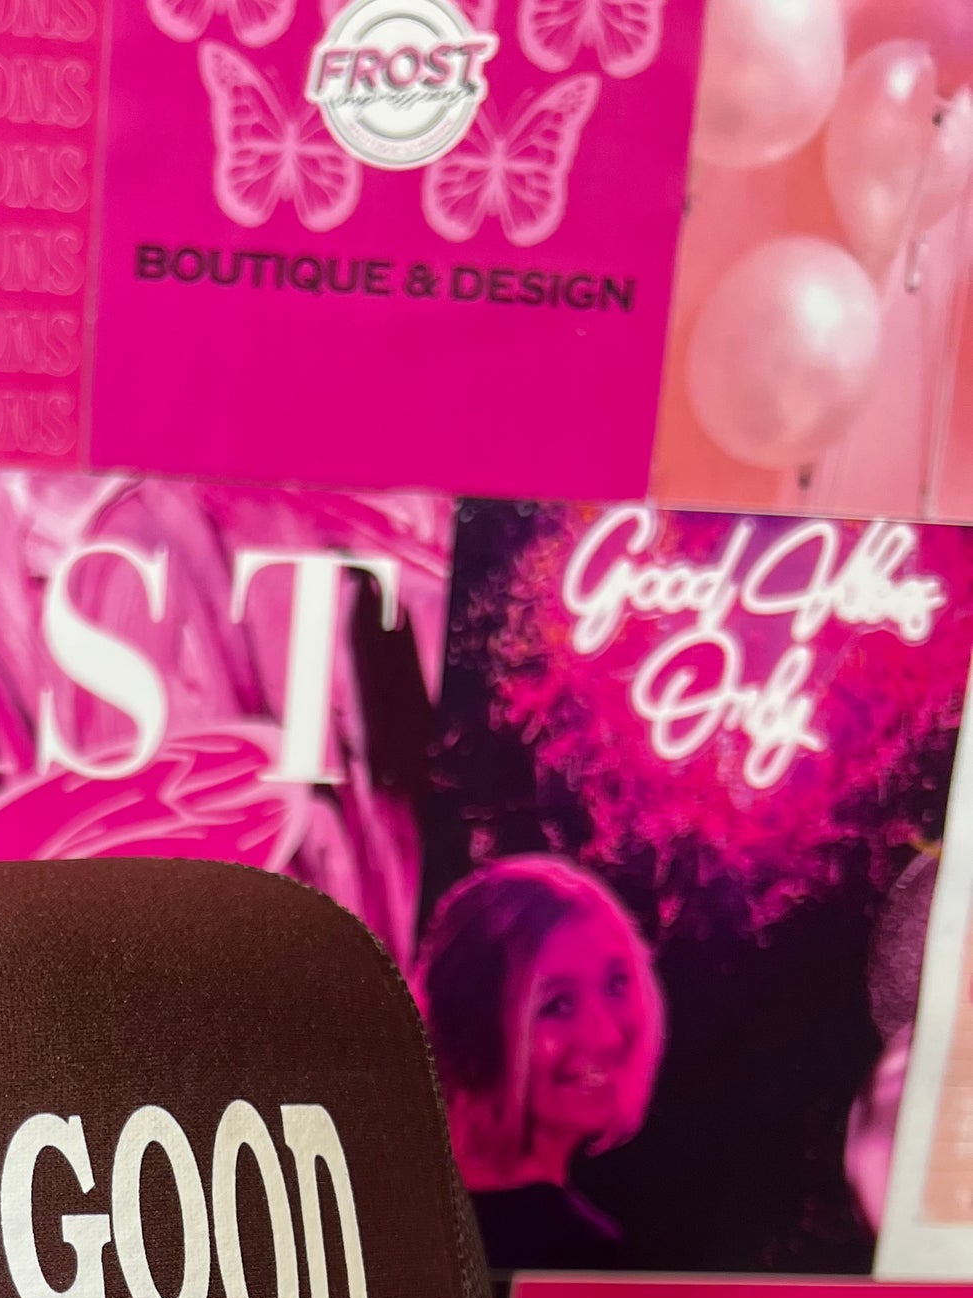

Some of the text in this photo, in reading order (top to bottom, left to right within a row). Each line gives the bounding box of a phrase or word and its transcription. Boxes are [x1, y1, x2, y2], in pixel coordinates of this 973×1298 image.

[316, 44, 488, 95] FROST
[135, 245, 636, 312] BOUTIQUE & DESIGN
[563, 506, 756, 655] Good
[632, 628, 824, 788] Only
